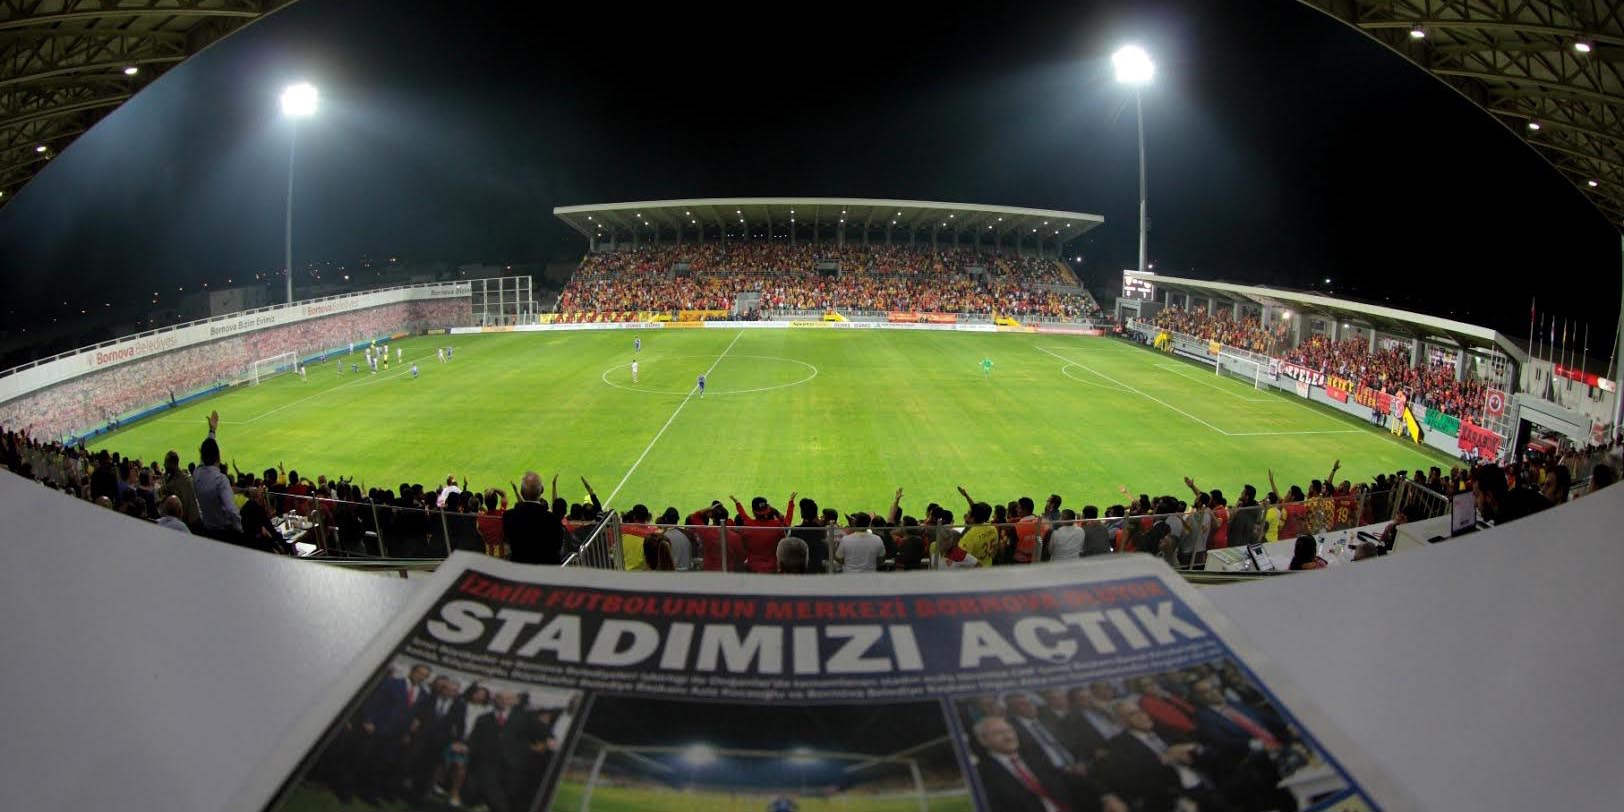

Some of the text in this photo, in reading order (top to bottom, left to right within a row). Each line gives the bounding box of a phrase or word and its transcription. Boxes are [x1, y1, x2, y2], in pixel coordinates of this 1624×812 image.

[209, 315, 276, 336] Bornova Bizim Evimiz
[96, 334, 177, 365] Bornova Belediyesi
[458, 574, 544, 607] İZMİR
[545, 591, 756, 621] FUTBOLUNUN
[764, 594, 907, 623] MERKEZİ
[426, 599, 925, 675] STADIMIZI
[959, 600, 1208, 669] AÇTIK
